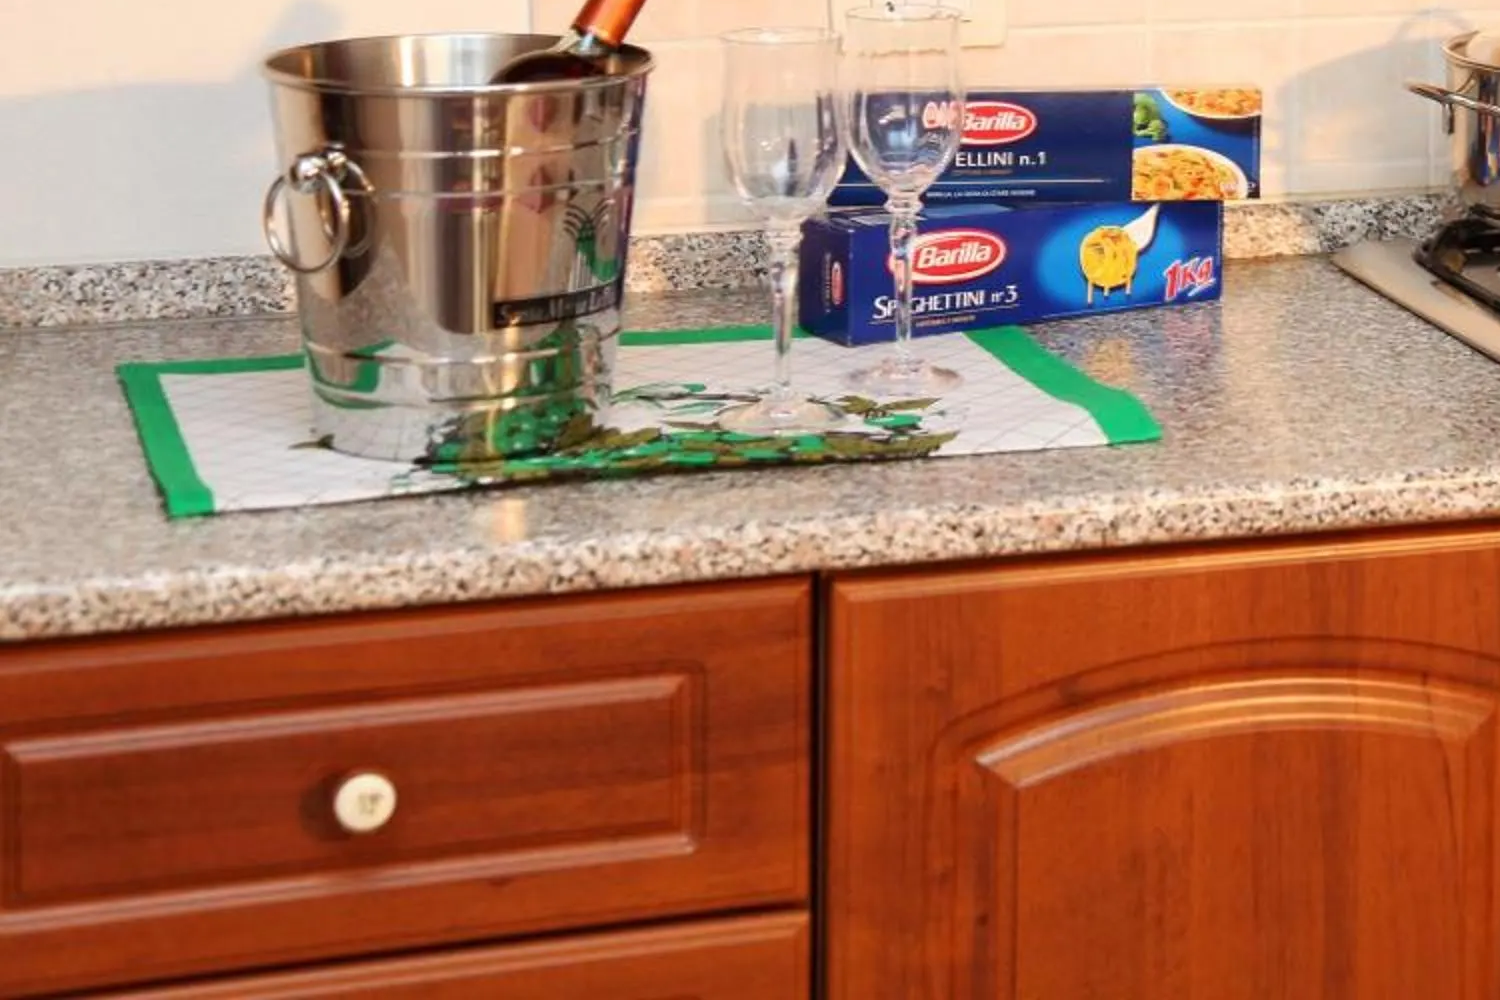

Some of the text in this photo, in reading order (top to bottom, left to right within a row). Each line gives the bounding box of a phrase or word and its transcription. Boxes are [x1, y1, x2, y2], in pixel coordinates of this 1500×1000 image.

[963, 111, 1026, 131] Barilla
[954, 151, 1013, 168] ELLINI
[917, 241, 993, 269] Barilla
[872, 289, 985, 319] SPGHETTINI
